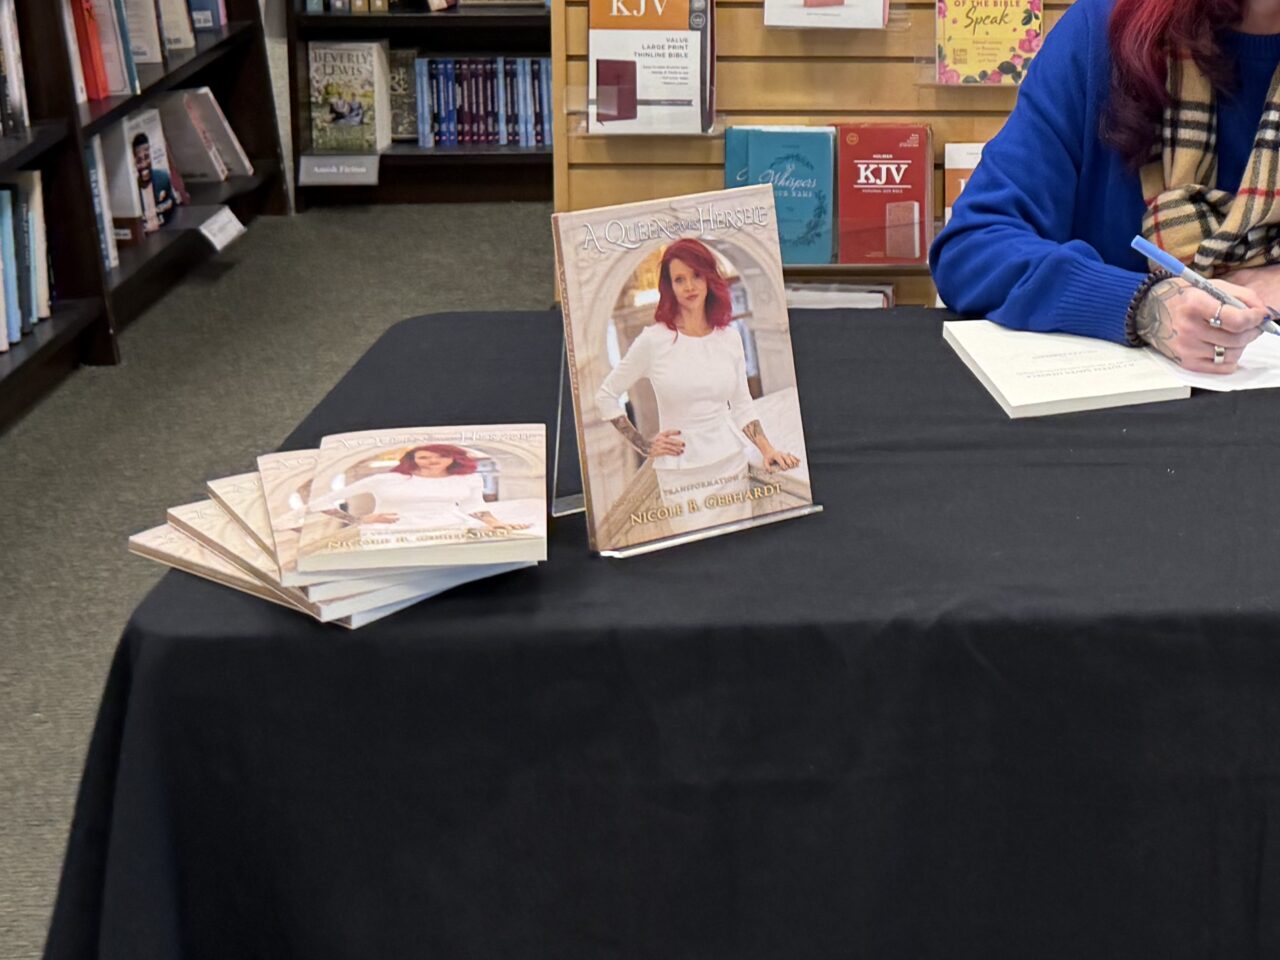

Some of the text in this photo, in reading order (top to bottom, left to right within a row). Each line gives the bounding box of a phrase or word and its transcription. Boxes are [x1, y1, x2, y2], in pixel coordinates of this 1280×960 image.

[993, 0, 1021, 8] BIBLE
[964, 4, 1009, 35] Speak
[313, 48, 370, 64] BEVERLY
[321, 62, 363, 77] LEWIS
[759, 170, 817, 189] Whispers
[857, 163, 909, 184] KJV
[582, 223, 606, 253] A
[605, 216, 679, 250] QUEEN
[696, 202, 769, 234] HERSELF
[629, 481, 783, 526] NICOLE B. GEBHARDT
